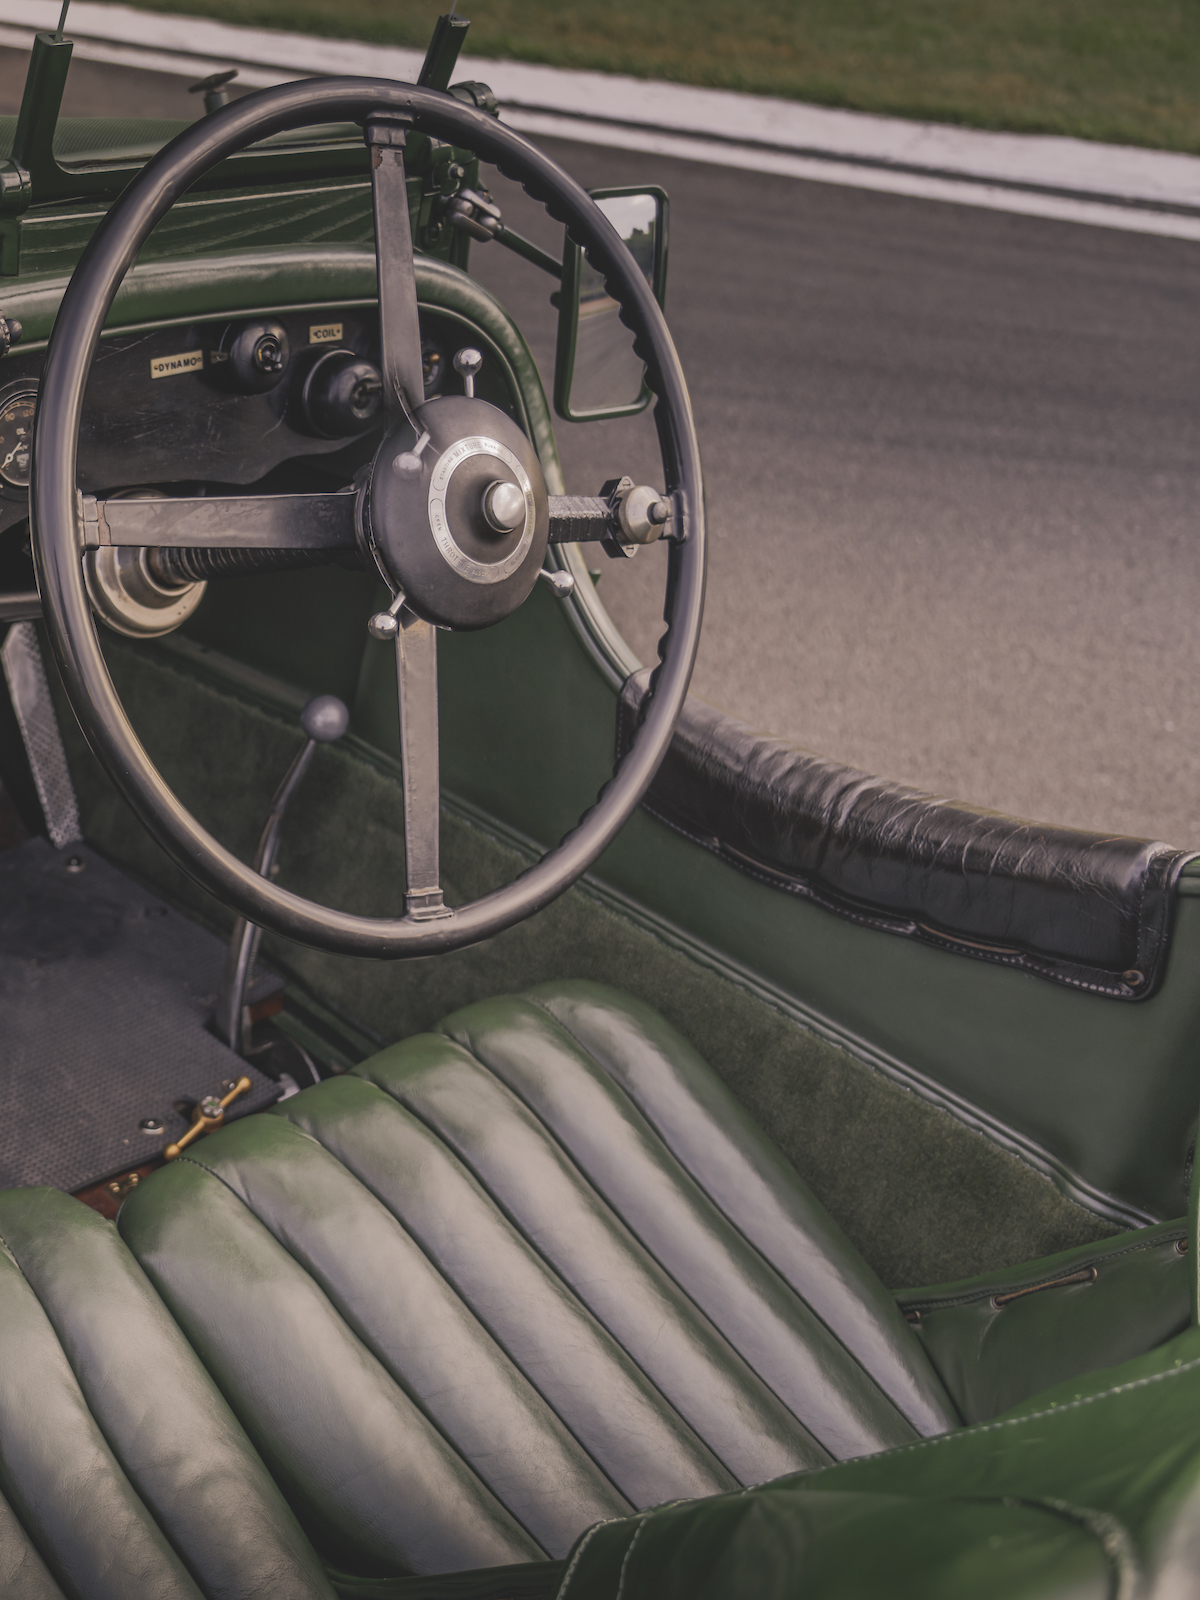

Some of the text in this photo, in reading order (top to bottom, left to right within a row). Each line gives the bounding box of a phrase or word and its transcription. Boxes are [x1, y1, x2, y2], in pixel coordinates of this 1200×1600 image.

[315, 329, 337, 339] COIL
[158, 358, 197, 372] DYNAMO
[23, 408, 35, 418] 120
[439, 456, 454, 481] STARTING
[453, 441, 482, 458] MIXTURE
[434, 514, 443, 532] OPEN
